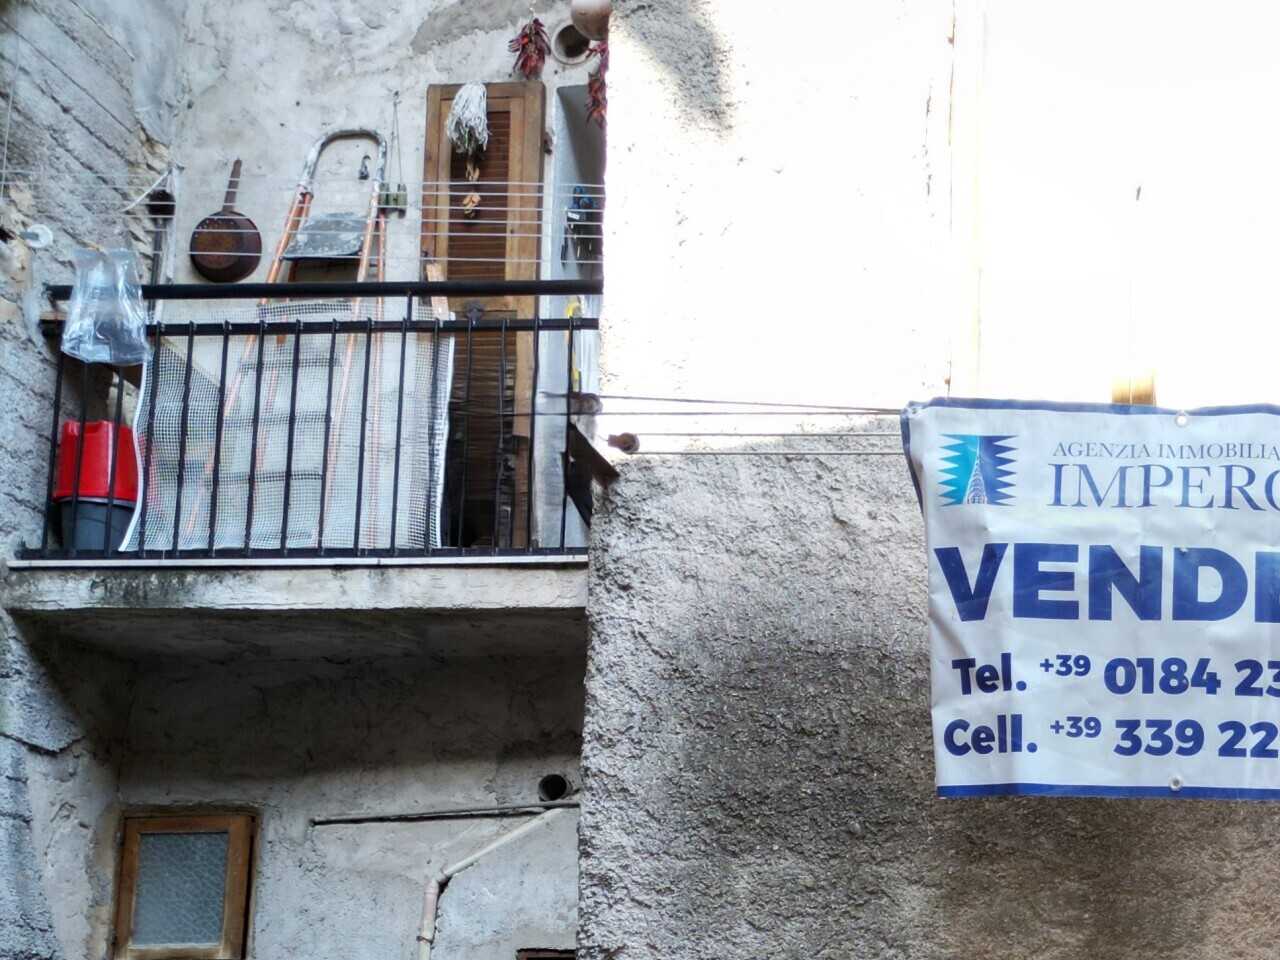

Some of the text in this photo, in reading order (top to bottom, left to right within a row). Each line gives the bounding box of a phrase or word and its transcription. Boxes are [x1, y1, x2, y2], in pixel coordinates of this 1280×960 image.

[1052, 441, 1154, 460] AGENZIA
[952, 652, 1028, 695] Tel.
[1039, 654, 1092, 677] +39
[1103, 657, 1221, 696] 0184
[943, 713, 1039, 757] Cell.
[1049, 716, 1102, 739] +39
[1114, 718, 1205, 758] 339
